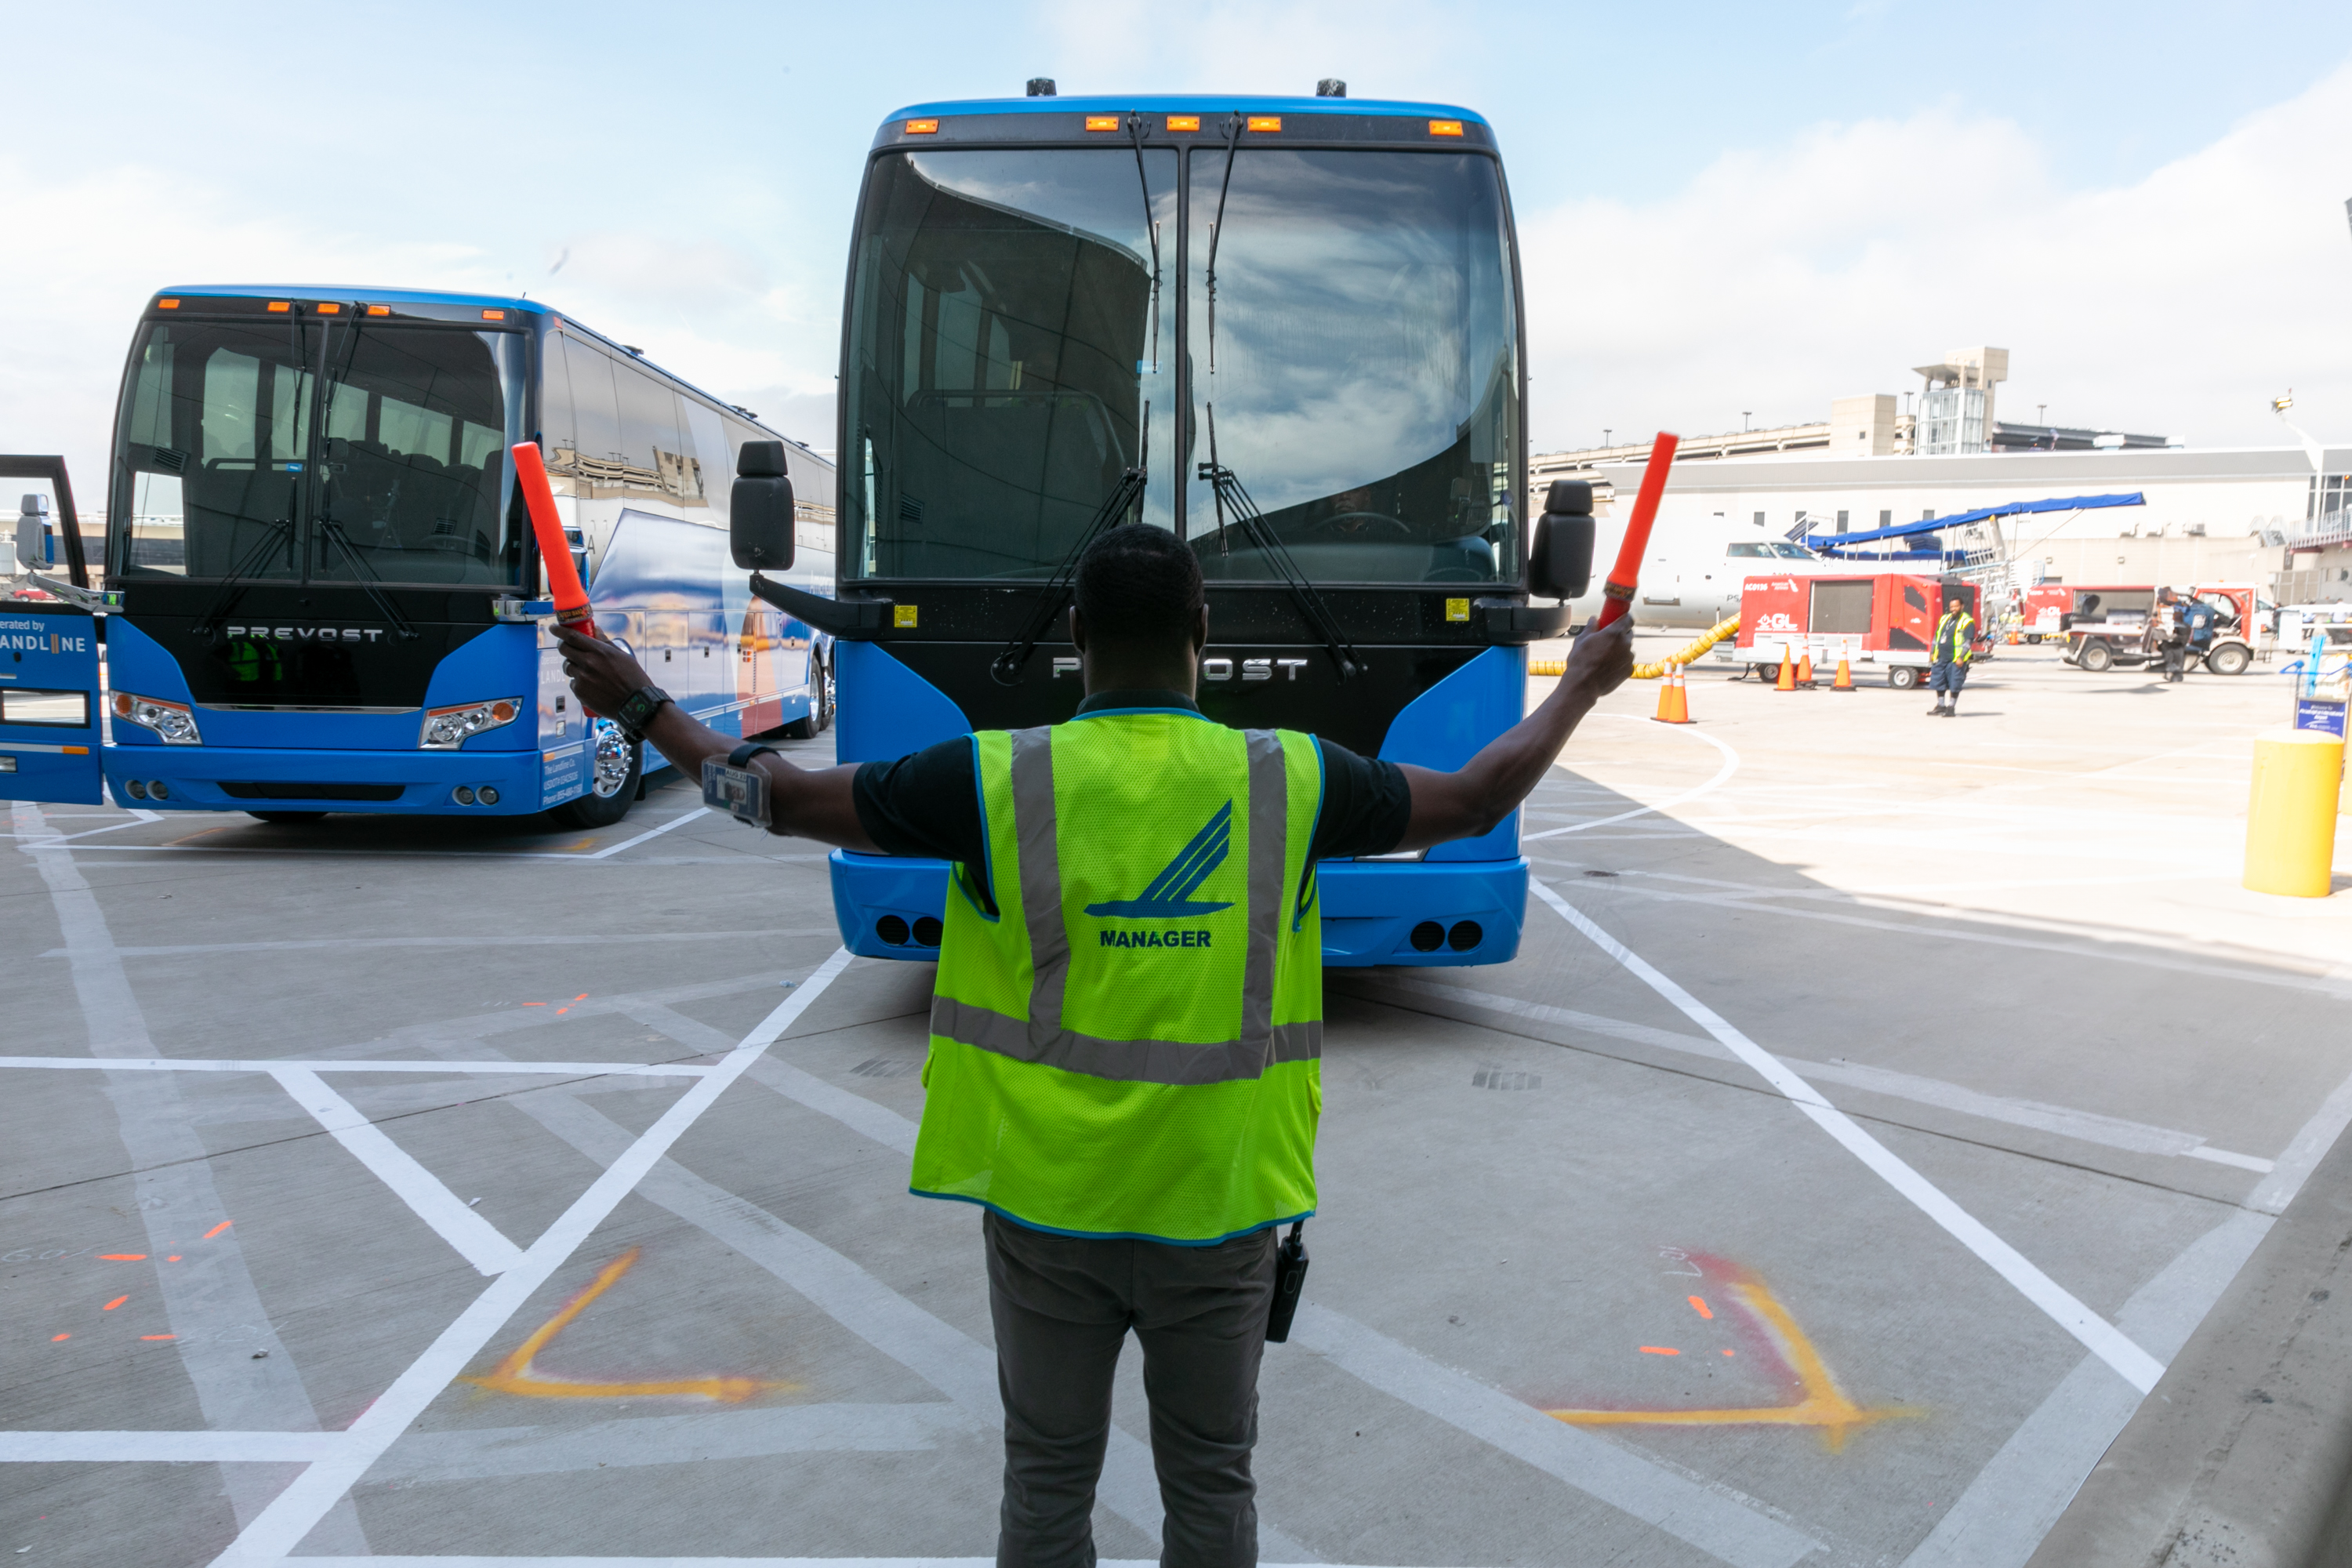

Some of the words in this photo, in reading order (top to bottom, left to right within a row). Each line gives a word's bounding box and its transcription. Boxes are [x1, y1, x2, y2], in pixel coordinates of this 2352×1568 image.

[0, 620, 30, 630] erated
[32, 620, 45, 632] by
[227, 626, 383, 642] PREVOST
[0, 633, 86, 654] ANDLINE
[1053, 657, 1308, 681] POST
[726, 768, 739, 779] AUG
[1100, 930, 1211, 948] MANAGER
